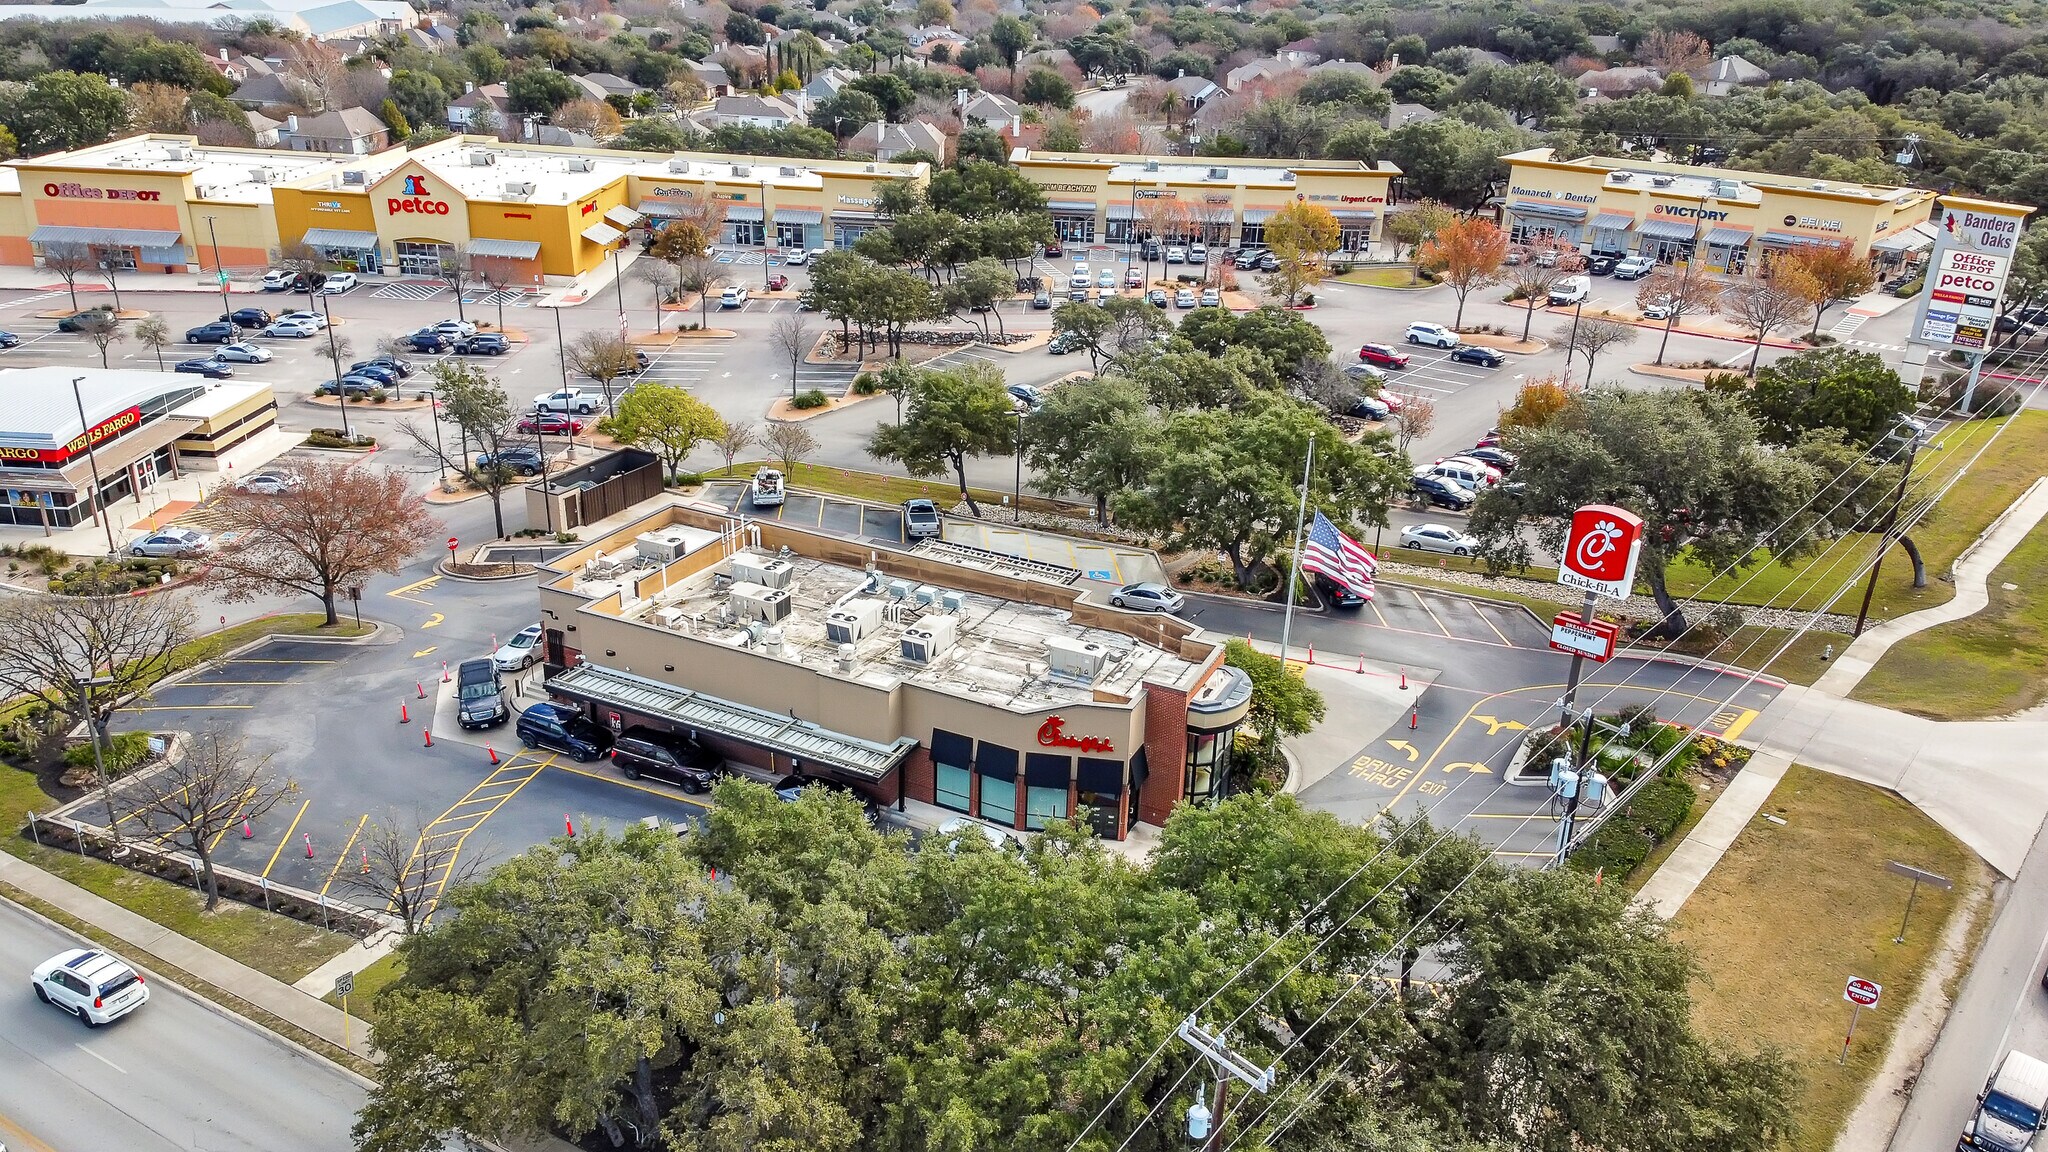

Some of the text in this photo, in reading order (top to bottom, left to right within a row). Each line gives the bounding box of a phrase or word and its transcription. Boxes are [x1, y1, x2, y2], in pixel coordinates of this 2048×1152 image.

[44, 183, 160, 201] Office DEPOT
[1058, 184, 1081, 192] BEACH
[1081, 185, 1097, 193] TAN
[1511, 186, 1597, 203] Monarch Dental
[388, 197, 449, 216] petco
[837, 194, 873, 207] Massage
[1341, 195, 1366, 204] Urgent
[1366, 195, 1384, 203] Care
[1665, 205, 1729, 221] VICTORY
[1800, 216, 1819, 226] PEI
[1821, 219, 1843, 230] WEI
[1964, 212, 2016, 233] Bandera
[1981, 232, 2012, 249] Oaks
[1953, 253, 1996, 267] Office
[1951, 262, 1994, 274] DEPOT
[1940, 273, 1995, 291] petco
[102, 412, 135, 435] FARGO
[447, 539, 459, 548] STOP
[405, 581, 439, 595] STOP
[1562, 572, 1620, 597] Chick-fil-A
[1560, 627, 1597, 641] PEPPERMINT
[1565, 622, 1598, 635] BREAKFAST
[1556, 643, 1597, 659] CLOSED SUNDAY
[1353, 755, 1414, 781] DRIVE
[1348, 765, 1401, 789] THRU
[1417, 780, 1448, 797] EXIT
[338, 983, 351, 995] 30
[1852, 981, 1876, 993] DO NOT
[1851, 992, 1871, 1003] ENTER
